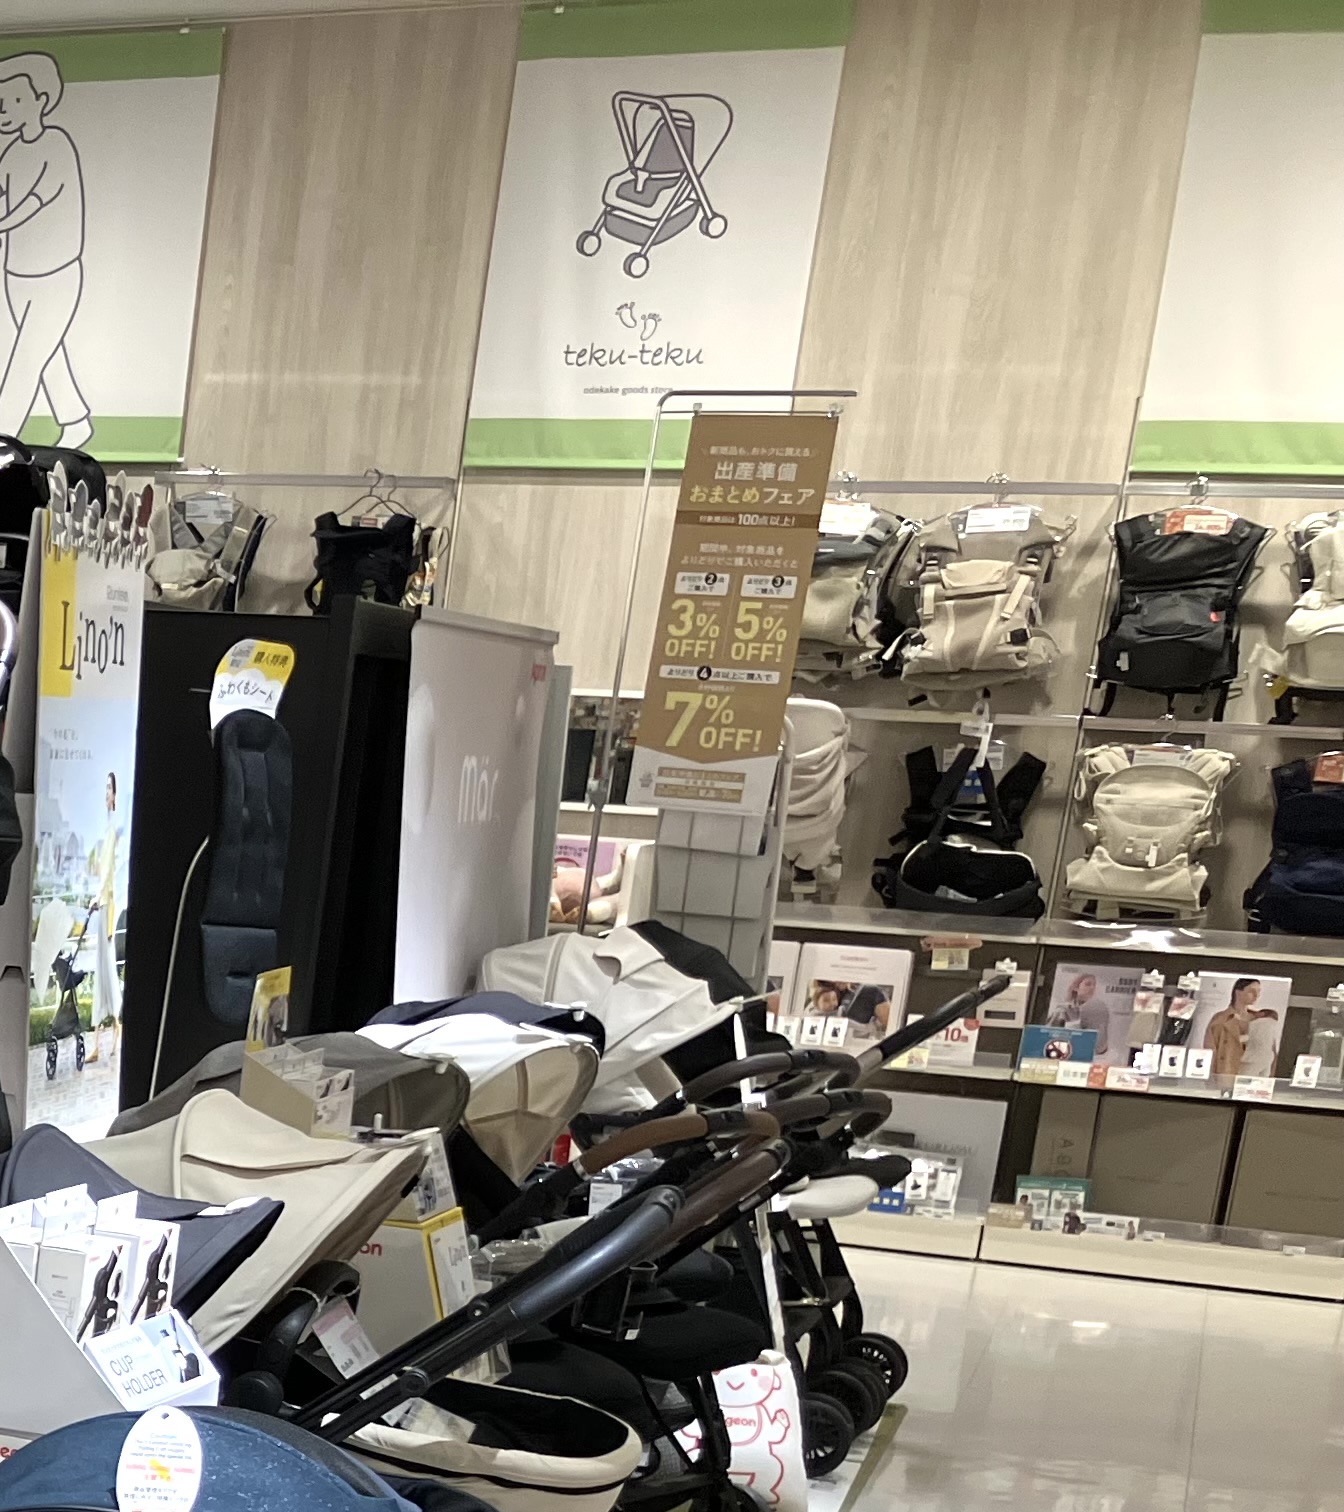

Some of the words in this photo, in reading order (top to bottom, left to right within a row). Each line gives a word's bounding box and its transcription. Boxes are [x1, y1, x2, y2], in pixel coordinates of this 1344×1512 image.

[563, 342, 704, 368] teku-teku
[714, 461, 798, 482] 出産準備
[689, 484, 815, 505] おまとめフェア
[667, 599, 720, 637] 3%
[733, 601, 788, 642] 5%
[664, 639, 717, 659] OFF!
[730, 642, 783, 662] OFF!
[217, 680, 277, 703] ふわくもシート
[664, 691, 734, 747] 7%
[699, 727, 763, 752] OFF!
[109, 1355, 135, 1376] CUP
[124, 1368, 169, 1398] HOLDER
